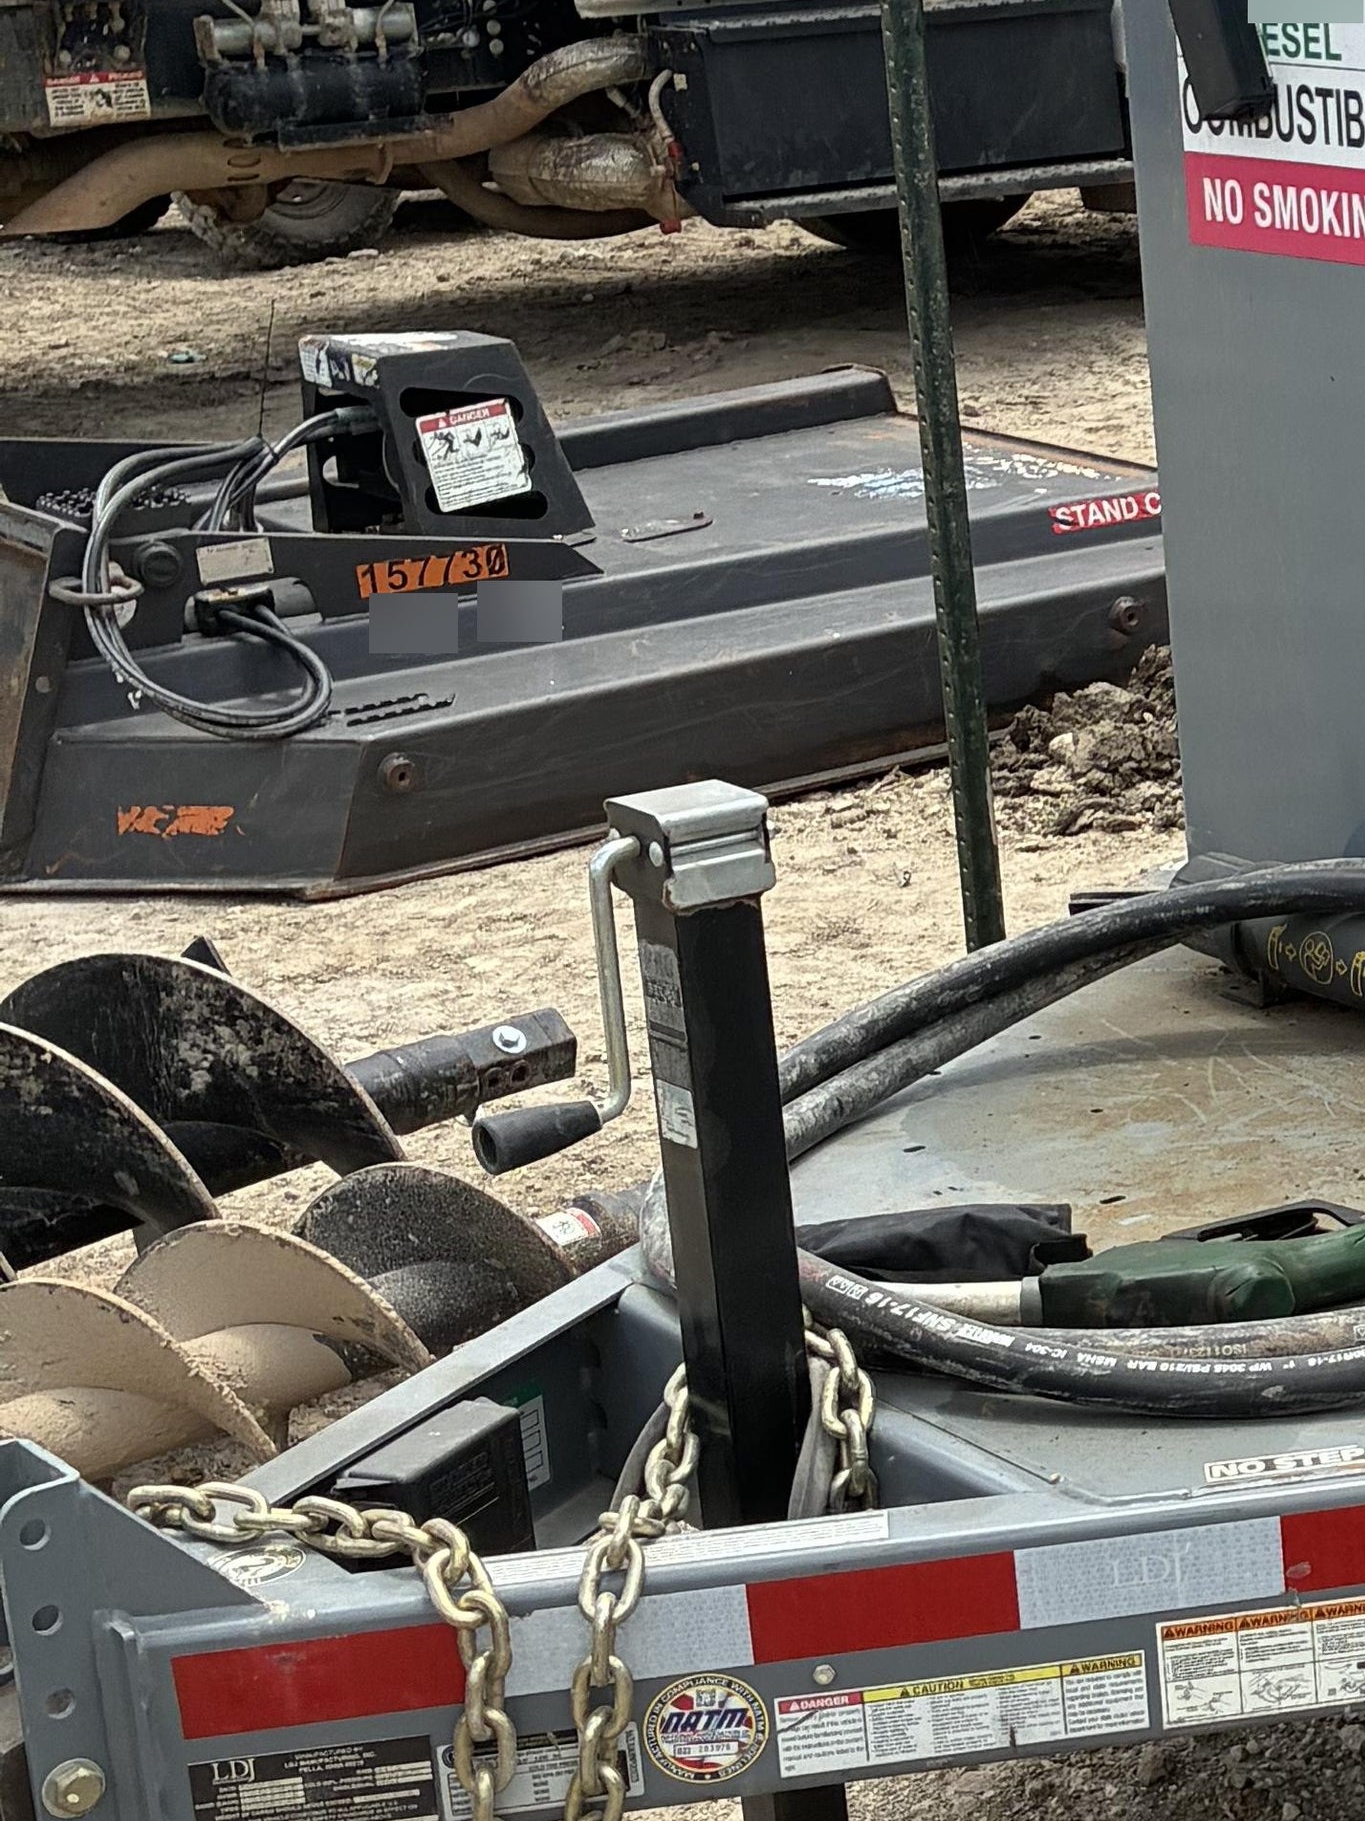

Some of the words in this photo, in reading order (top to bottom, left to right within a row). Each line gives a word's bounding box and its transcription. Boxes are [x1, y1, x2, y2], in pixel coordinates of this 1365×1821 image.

[1203, 177, 1243, 224] NO
[449, 408, 490, 425] DANGER
[1056, 496, 1139, 530] STAND
[361, 545, 506, 594] 157730
[1211, 1460, 1265, 1478] NO
[1273, 1447, 1365, 1470] STEP
[1176, 1623, 1235, 1638] WARNING
[1081, 1656, 1136, 1672] WARNING
[912, 1679, 964, 1696] CAUTION
[801, 1695, 849, 1710] DANGER
[212, 1758, 255, 1782] LDJ
